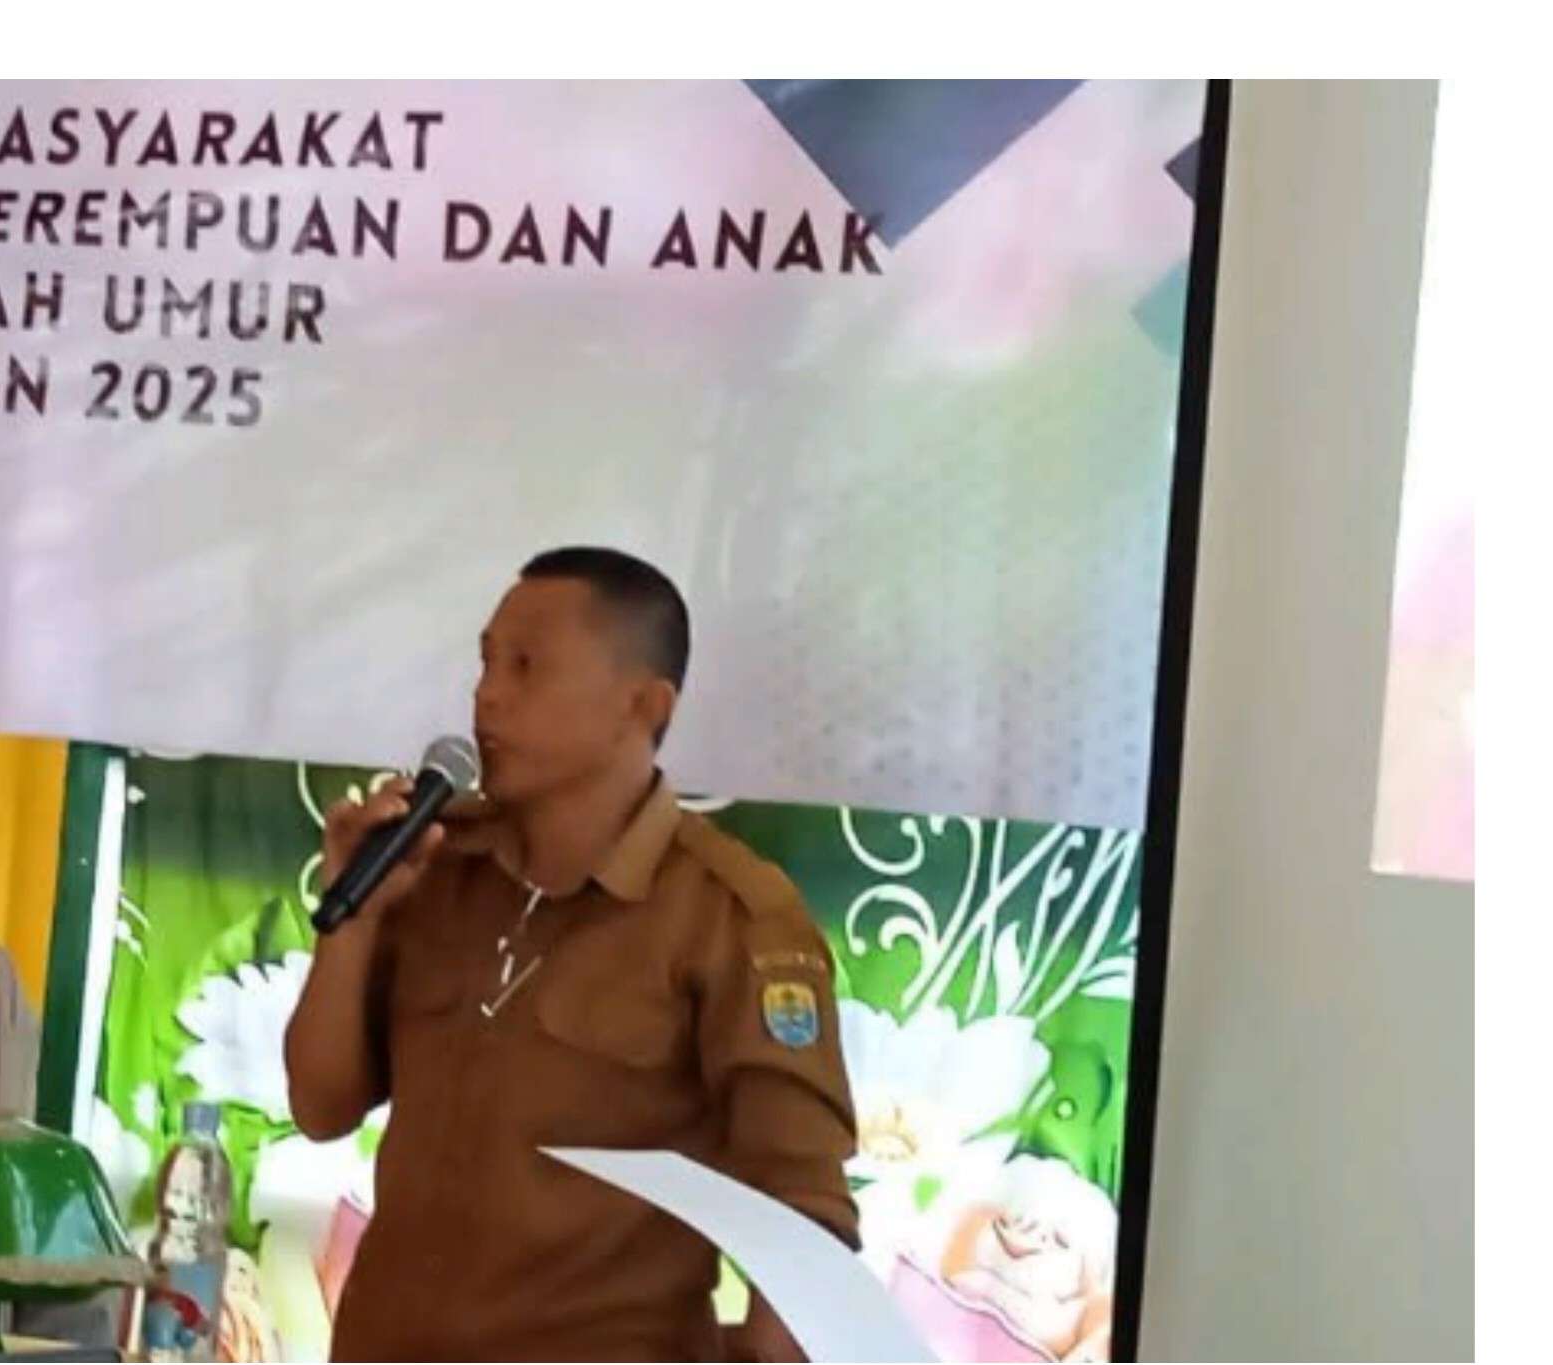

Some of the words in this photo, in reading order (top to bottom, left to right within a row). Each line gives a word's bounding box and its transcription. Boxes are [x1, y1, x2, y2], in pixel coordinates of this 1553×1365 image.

[442, 200, 613, 268] DAN
[649, 207, 884, 275] ANAK
[102, 274, 327, 344] UMUR
[84, 359, 264, 428] 2025
